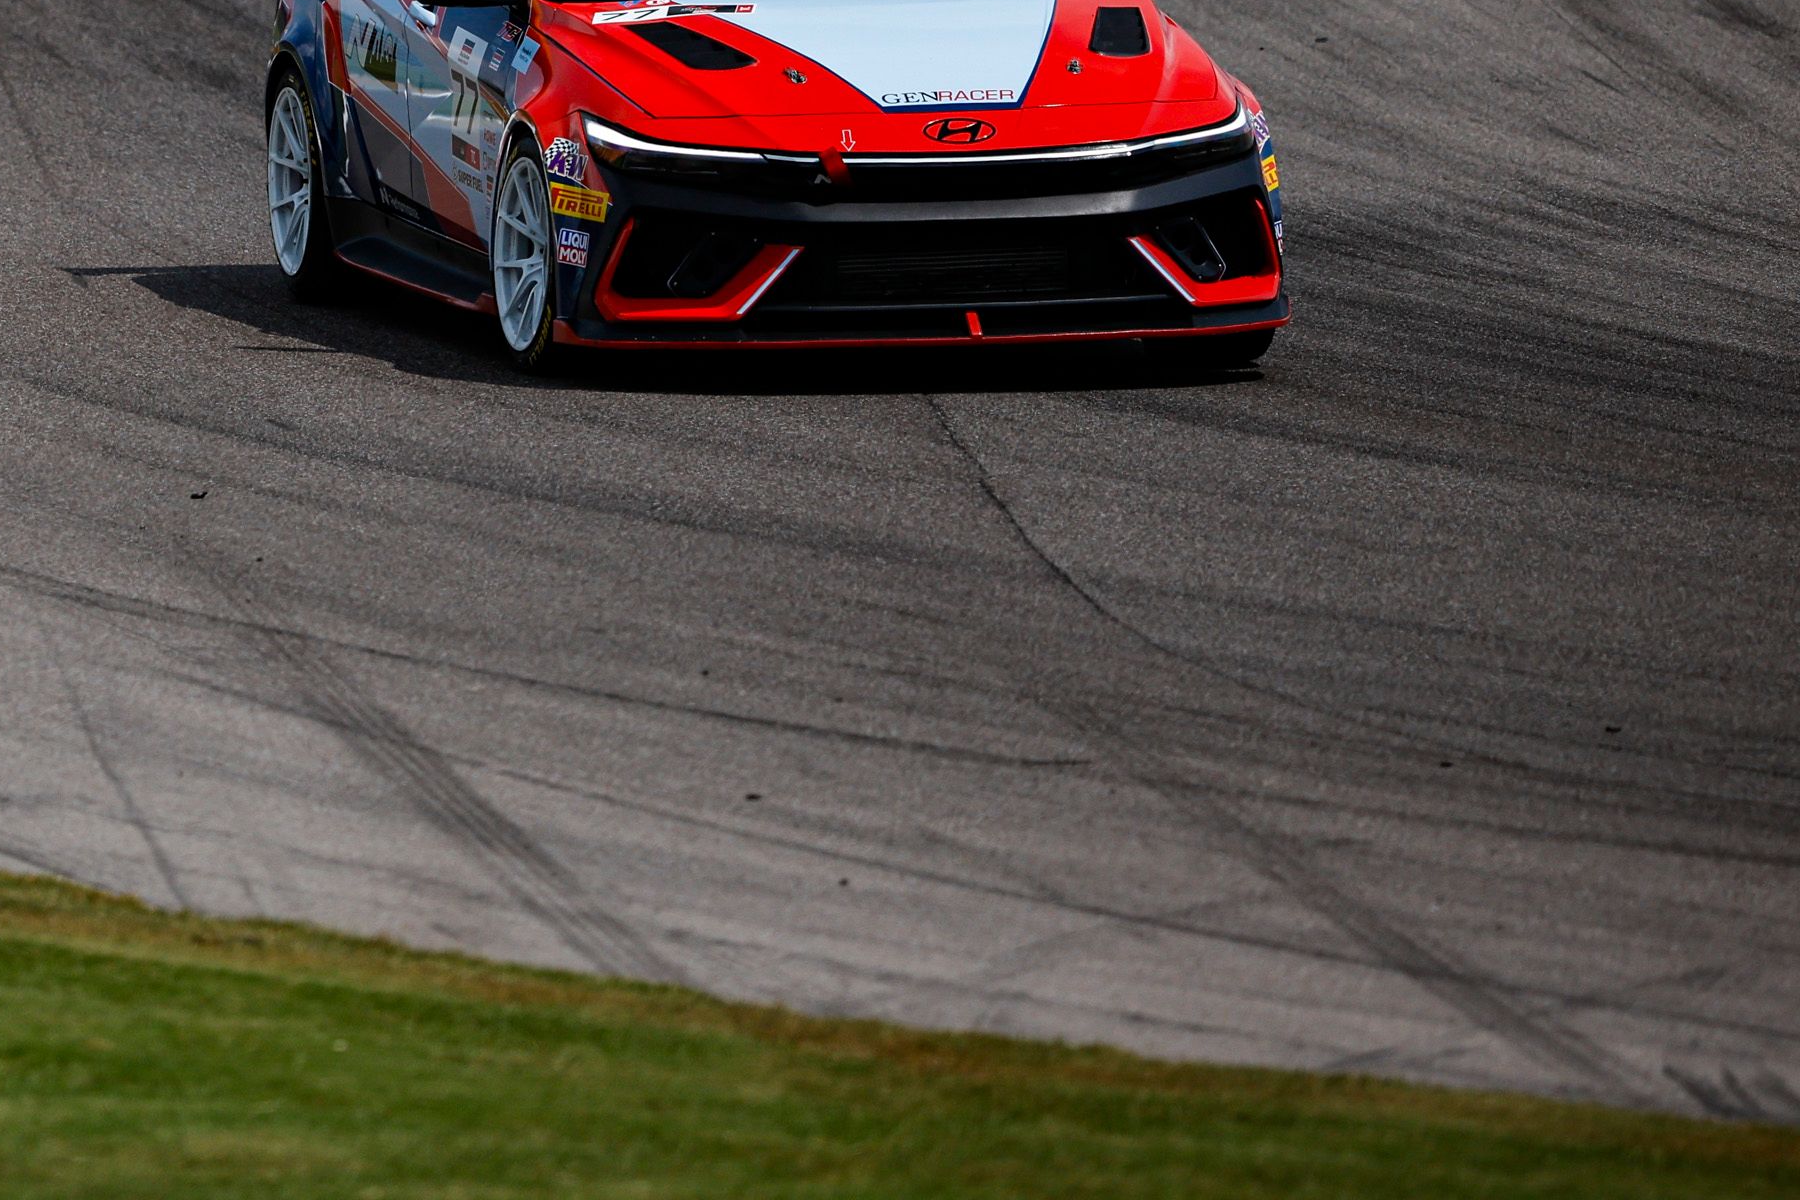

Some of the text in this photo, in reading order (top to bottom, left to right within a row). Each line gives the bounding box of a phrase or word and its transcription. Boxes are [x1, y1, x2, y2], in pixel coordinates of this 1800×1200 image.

[602, 8, 659, 21] 77
[451, 68, 479, 134] 77
[881, 90, 1014, 104] GENRACER
[458, 170, 473, 188] SUPER
[551, 187, 604, 218] PIRELLI
[561, 230, 588, 251] LIQUI
[559, 247, 587, 266] MOLY
